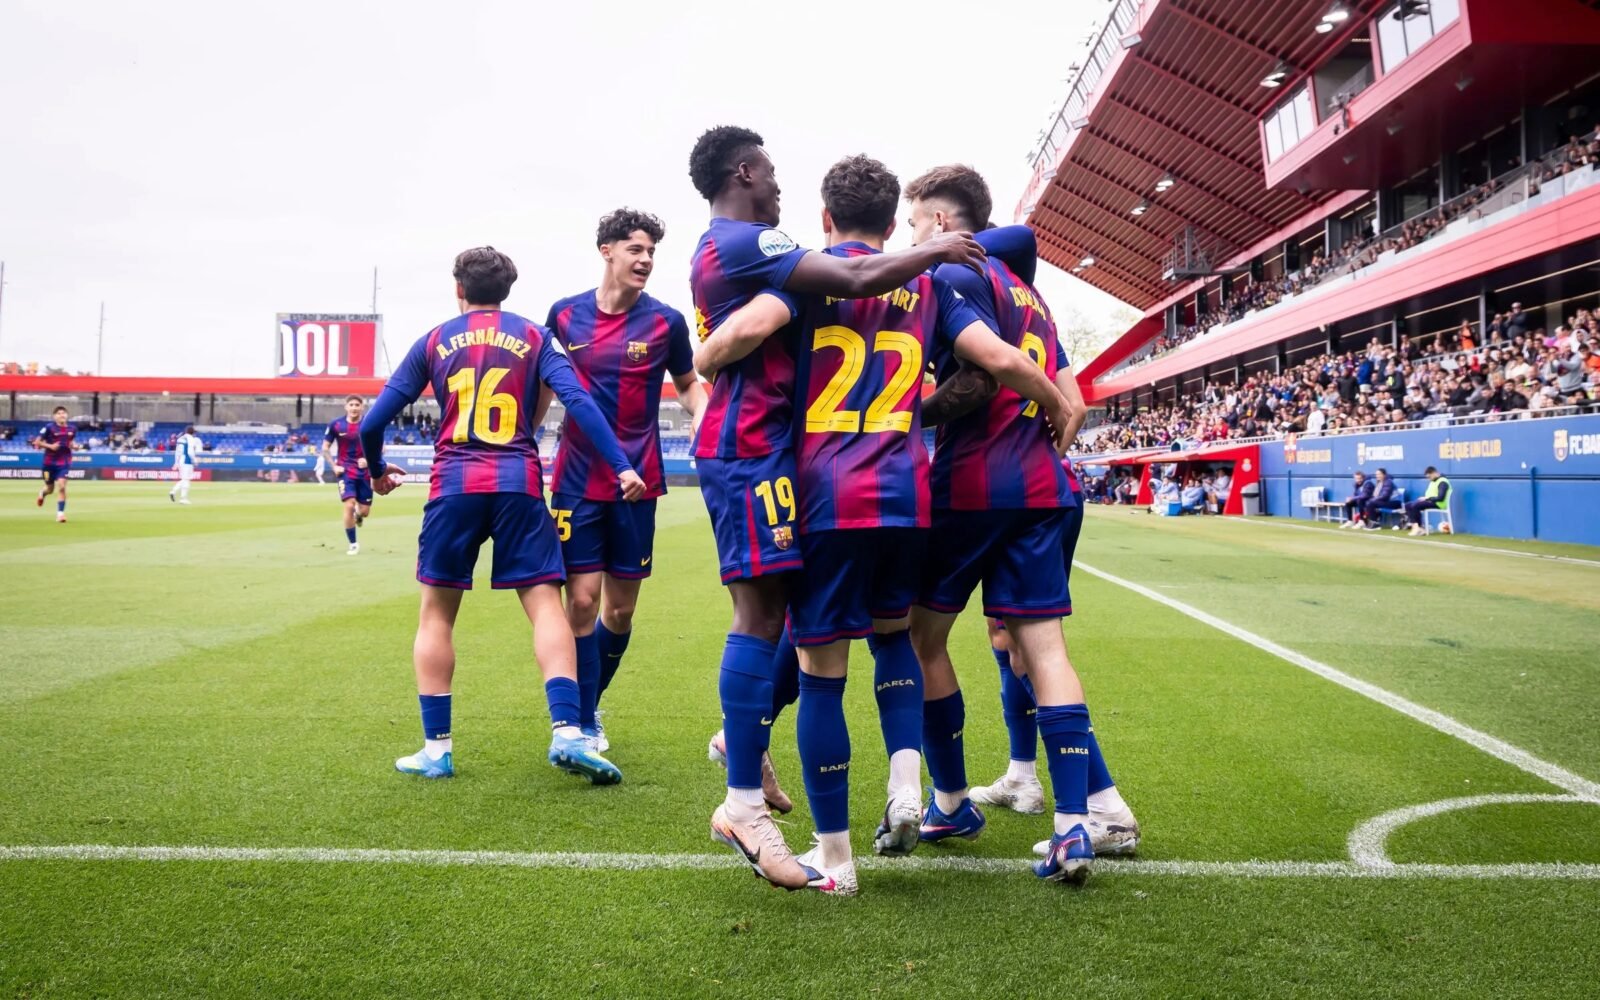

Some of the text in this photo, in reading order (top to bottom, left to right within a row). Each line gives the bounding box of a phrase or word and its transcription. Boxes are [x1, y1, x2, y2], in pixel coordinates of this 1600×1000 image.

[290, 313, 379, 321] ESTADI JOHAN CRUYFF
[806, 324, 922, 433] 22
[447, 367, 518, 445] 16
[1569, 435, 1583, 455] FC
[755, 476, 796, 526] 19
